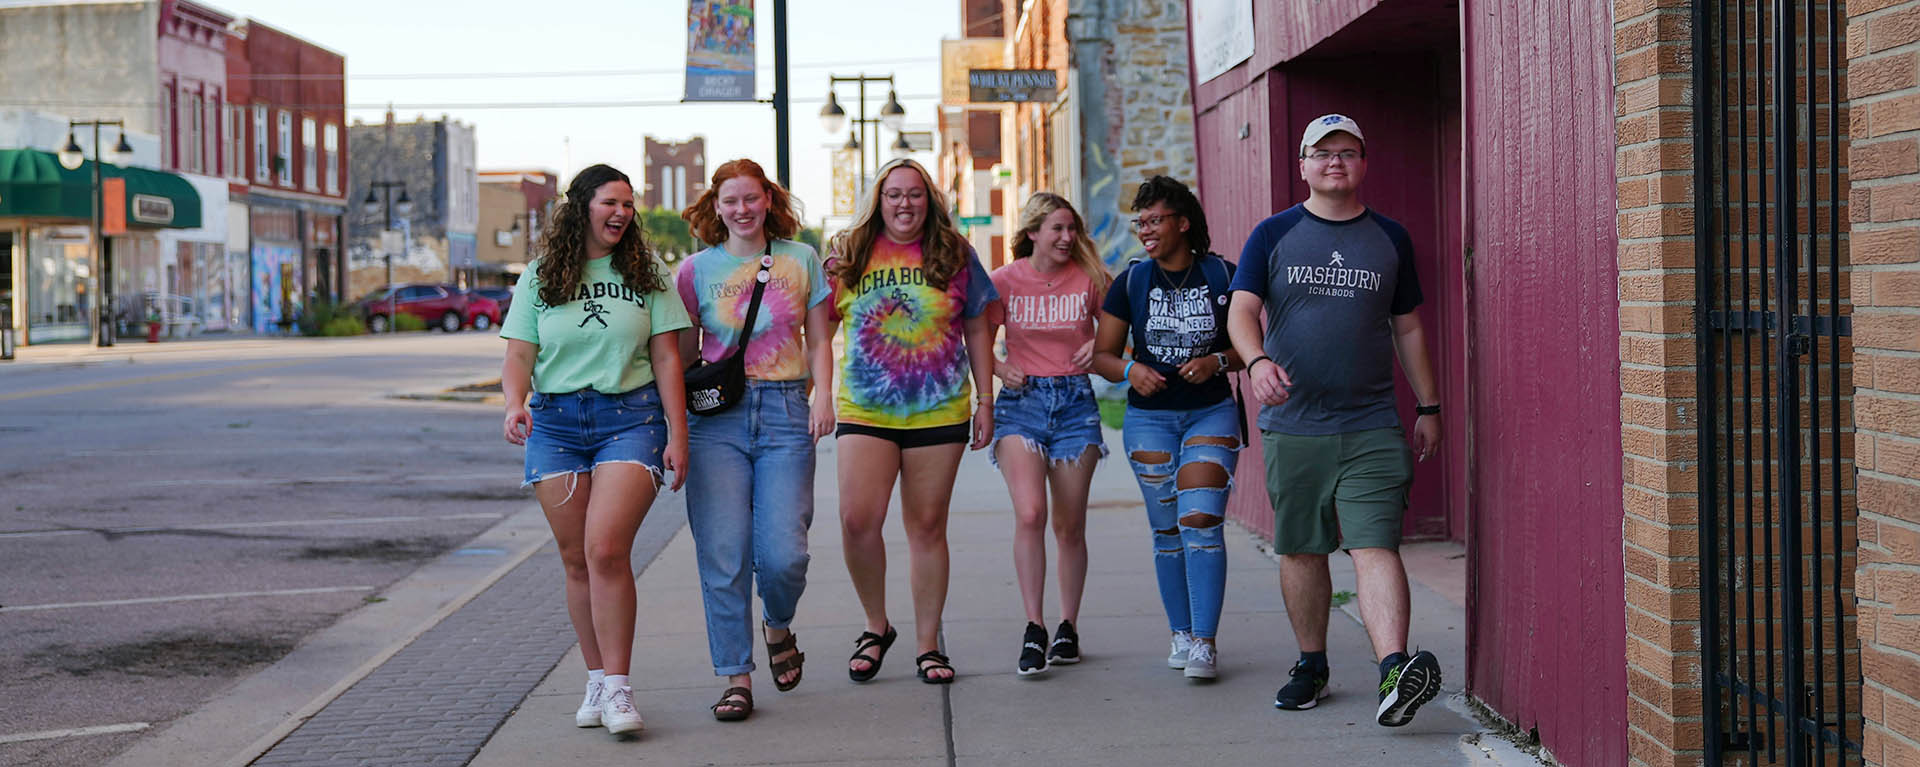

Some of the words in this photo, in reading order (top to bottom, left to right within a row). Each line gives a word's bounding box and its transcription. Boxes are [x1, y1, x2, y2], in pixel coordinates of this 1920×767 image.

[856, 266, 932, 299] ICHABO
[1286, 265, 1382, 293] WASHBURN
[1309, 286, 1355, 298] ICHABODS
[1008, 291, 1089, 323] ICHABODS
[1149, 297, 1213, 318] WASHBURN
[1174, 346, 1193, 358] THE
